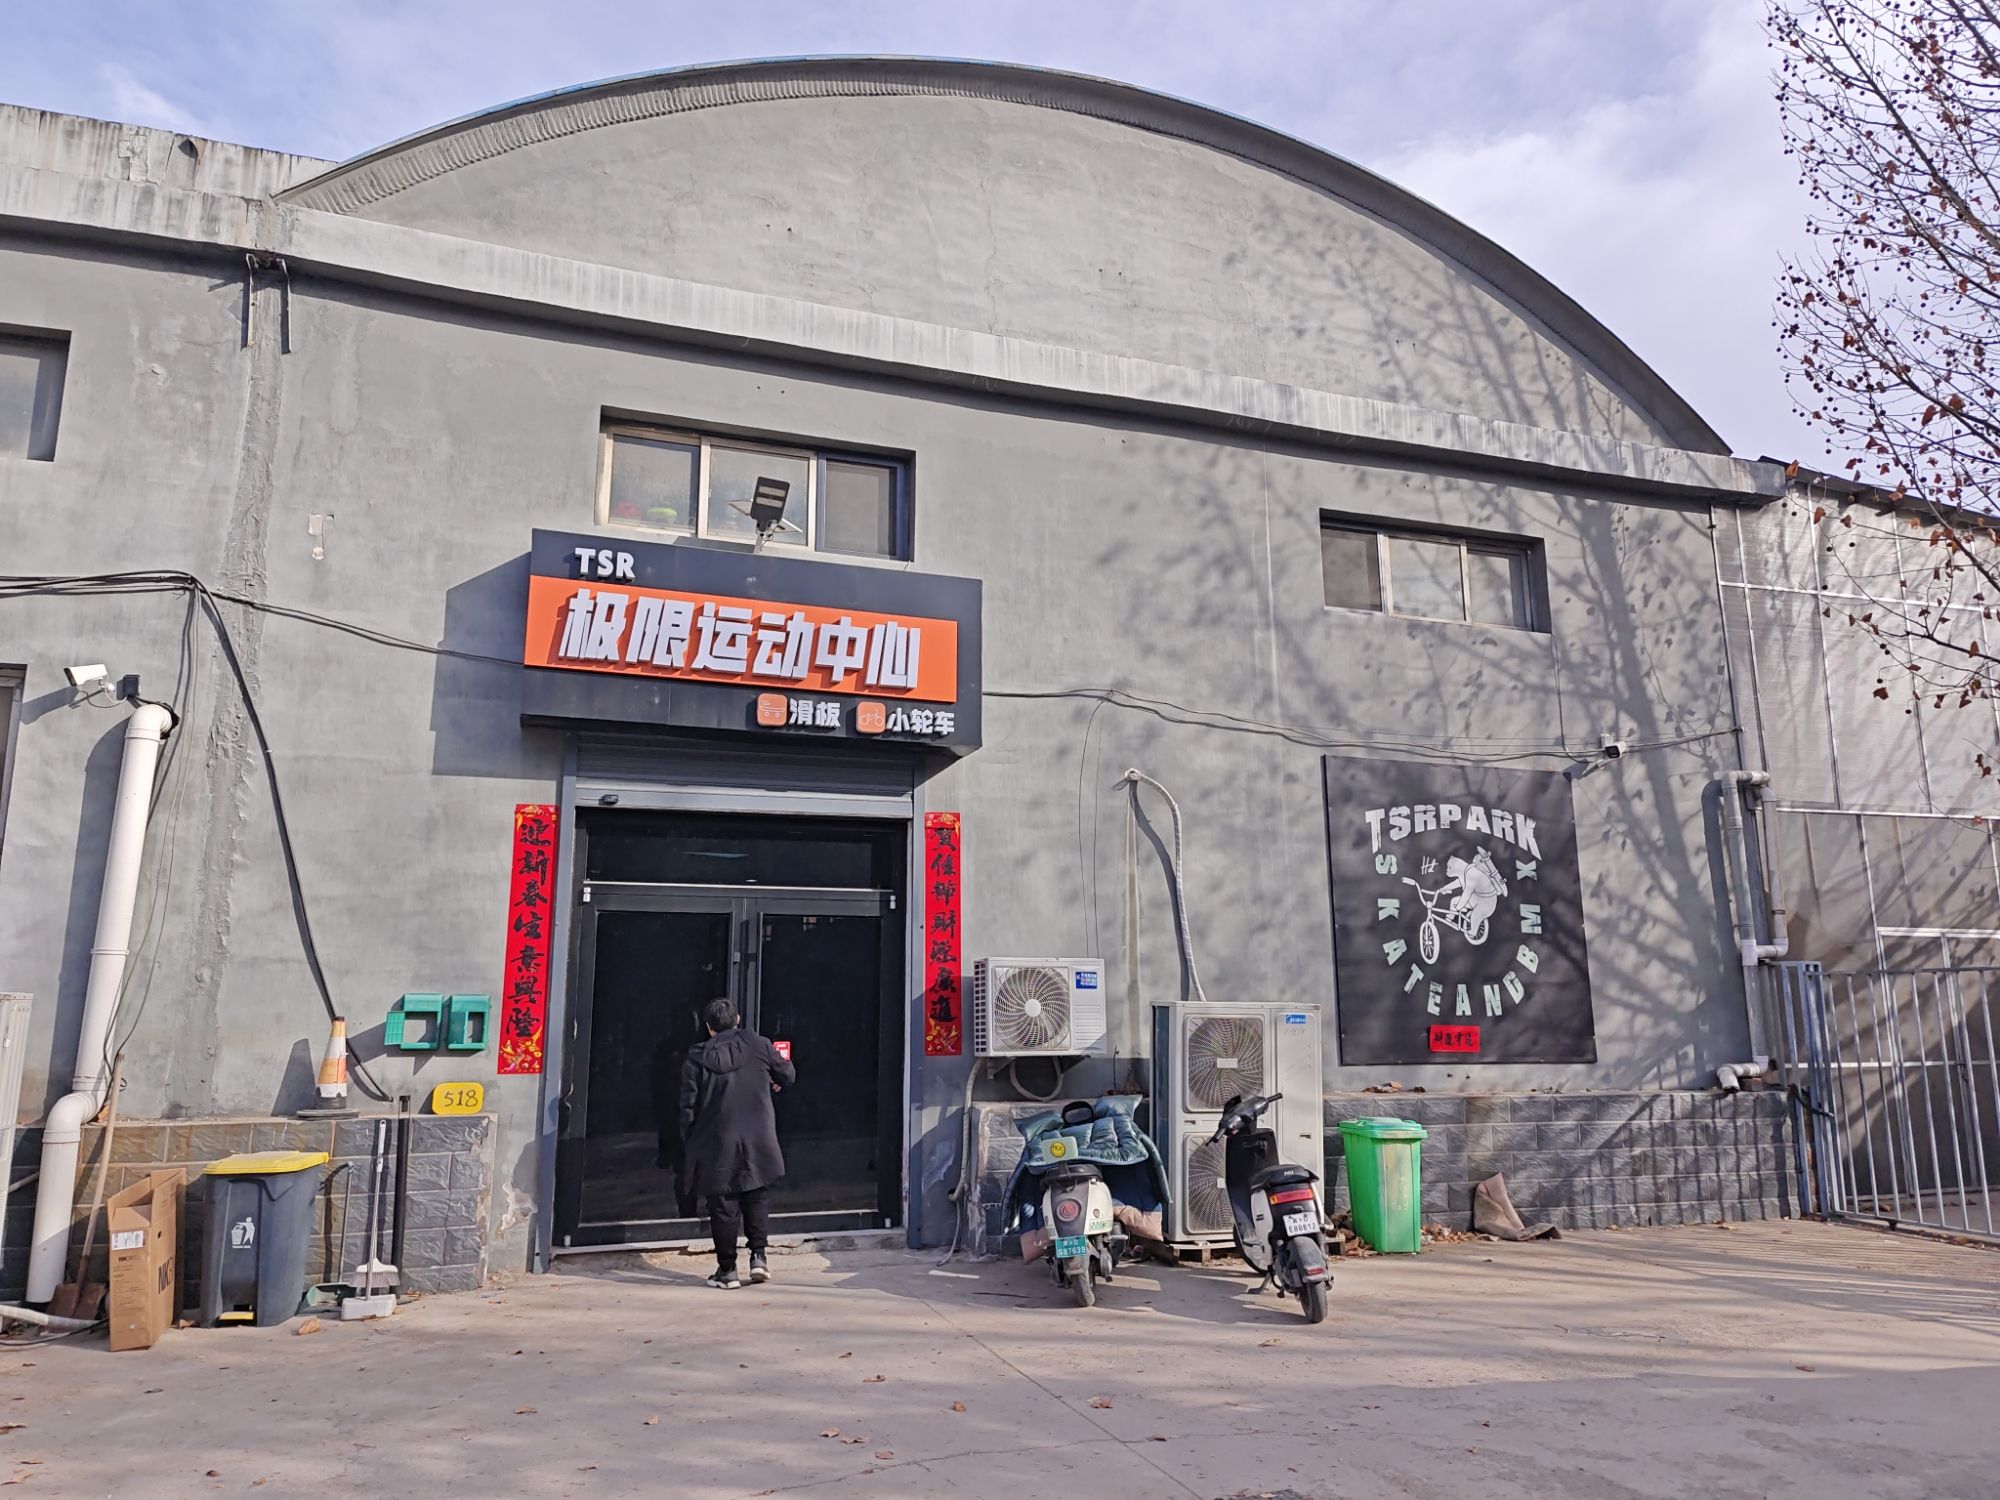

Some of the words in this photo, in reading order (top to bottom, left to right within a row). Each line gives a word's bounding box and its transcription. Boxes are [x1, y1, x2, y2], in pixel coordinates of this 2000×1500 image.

[574, 547, 635, 580] TSR
[558, 588, 921, 689] 极限运动中心
[789, 697, 841, 729] 滑板
[886, 707, 955, 736] 小轮车
[443, 1089, 479, 1108] 518
